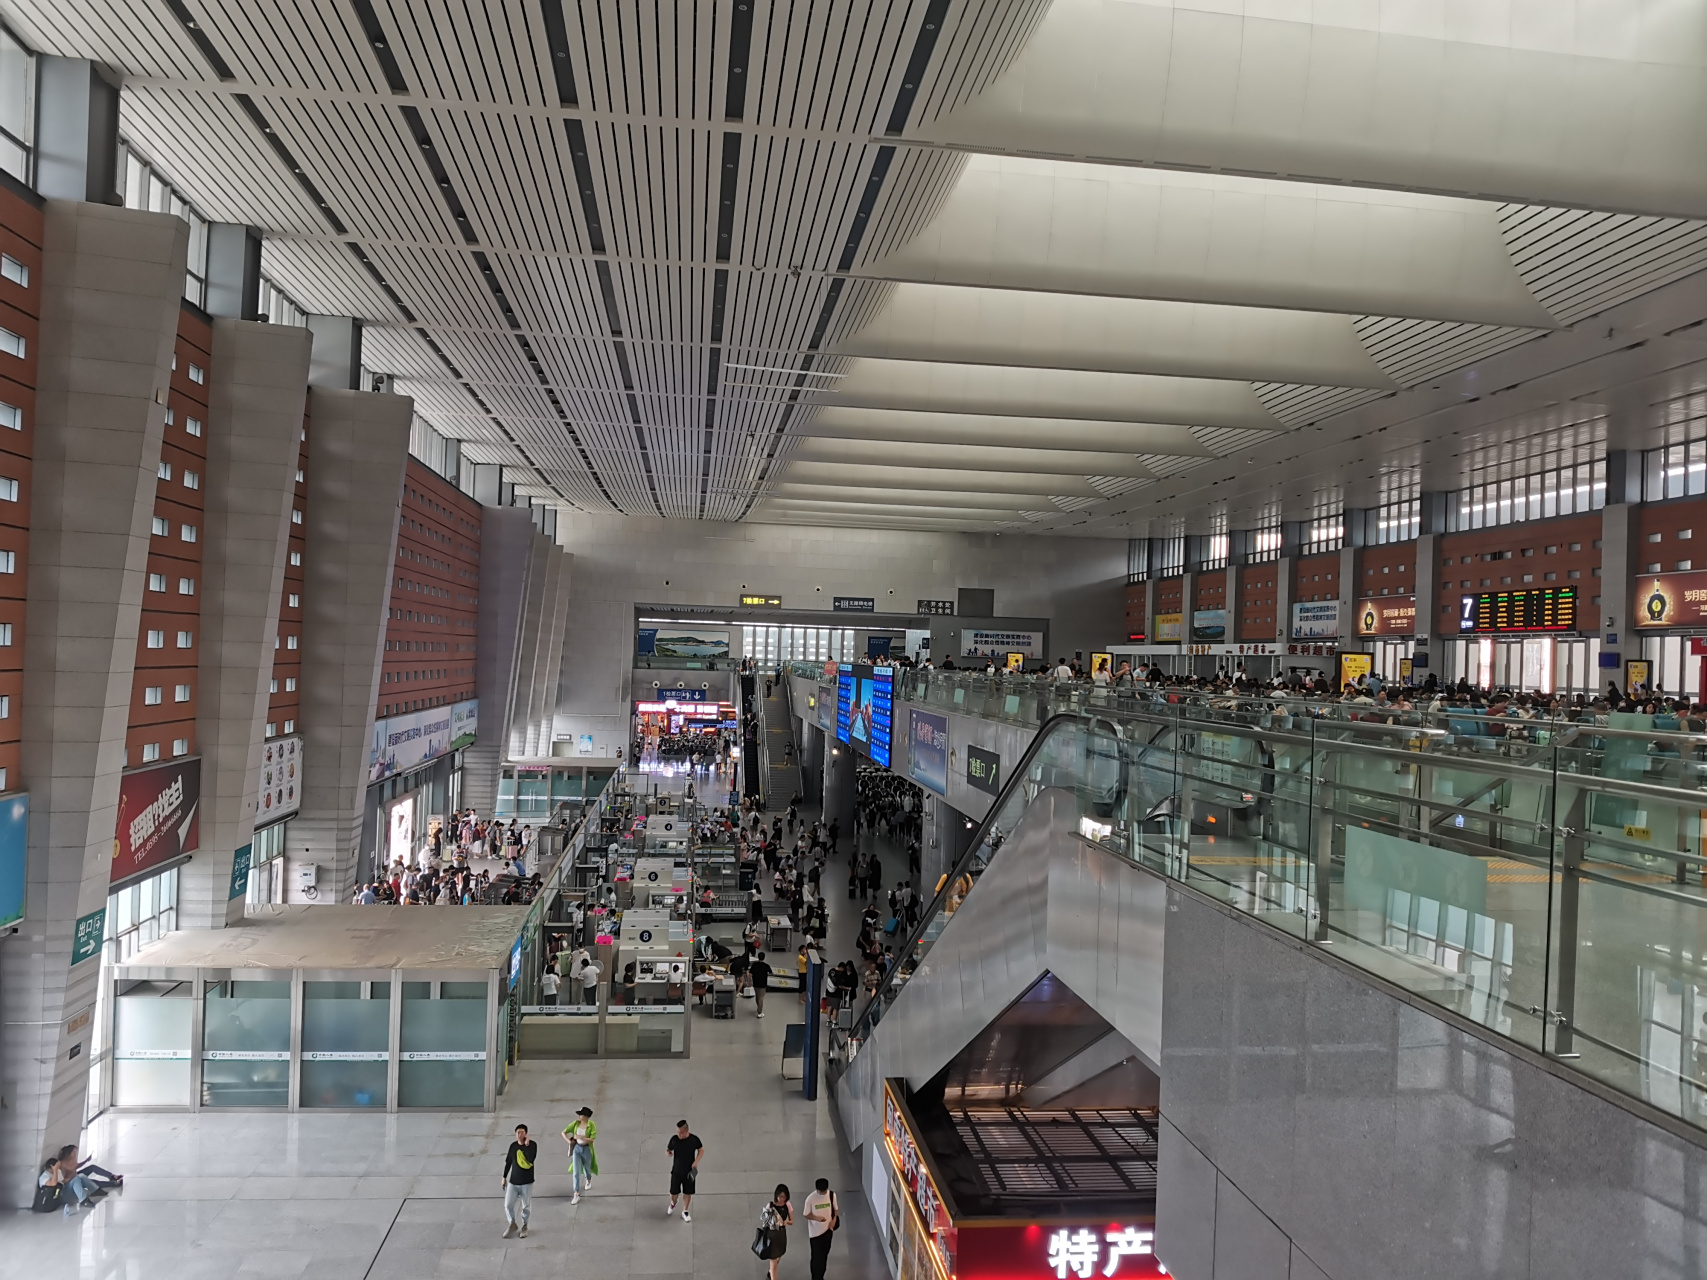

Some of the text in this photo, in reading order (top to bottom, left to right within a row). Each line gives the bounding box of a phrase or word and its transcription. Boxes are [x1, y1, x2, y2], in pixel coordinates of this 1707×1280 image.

[1462, 598, 1473, 618] 7
[1239, 644, 1266, 654] 特产超市
[1288, 645, 1336, 656] 便利超市
[969, 757, 986, 778] 7检票口
[78, 919, 93, 937] 出口
[1048, 1227, 1166, 1279] 特产
